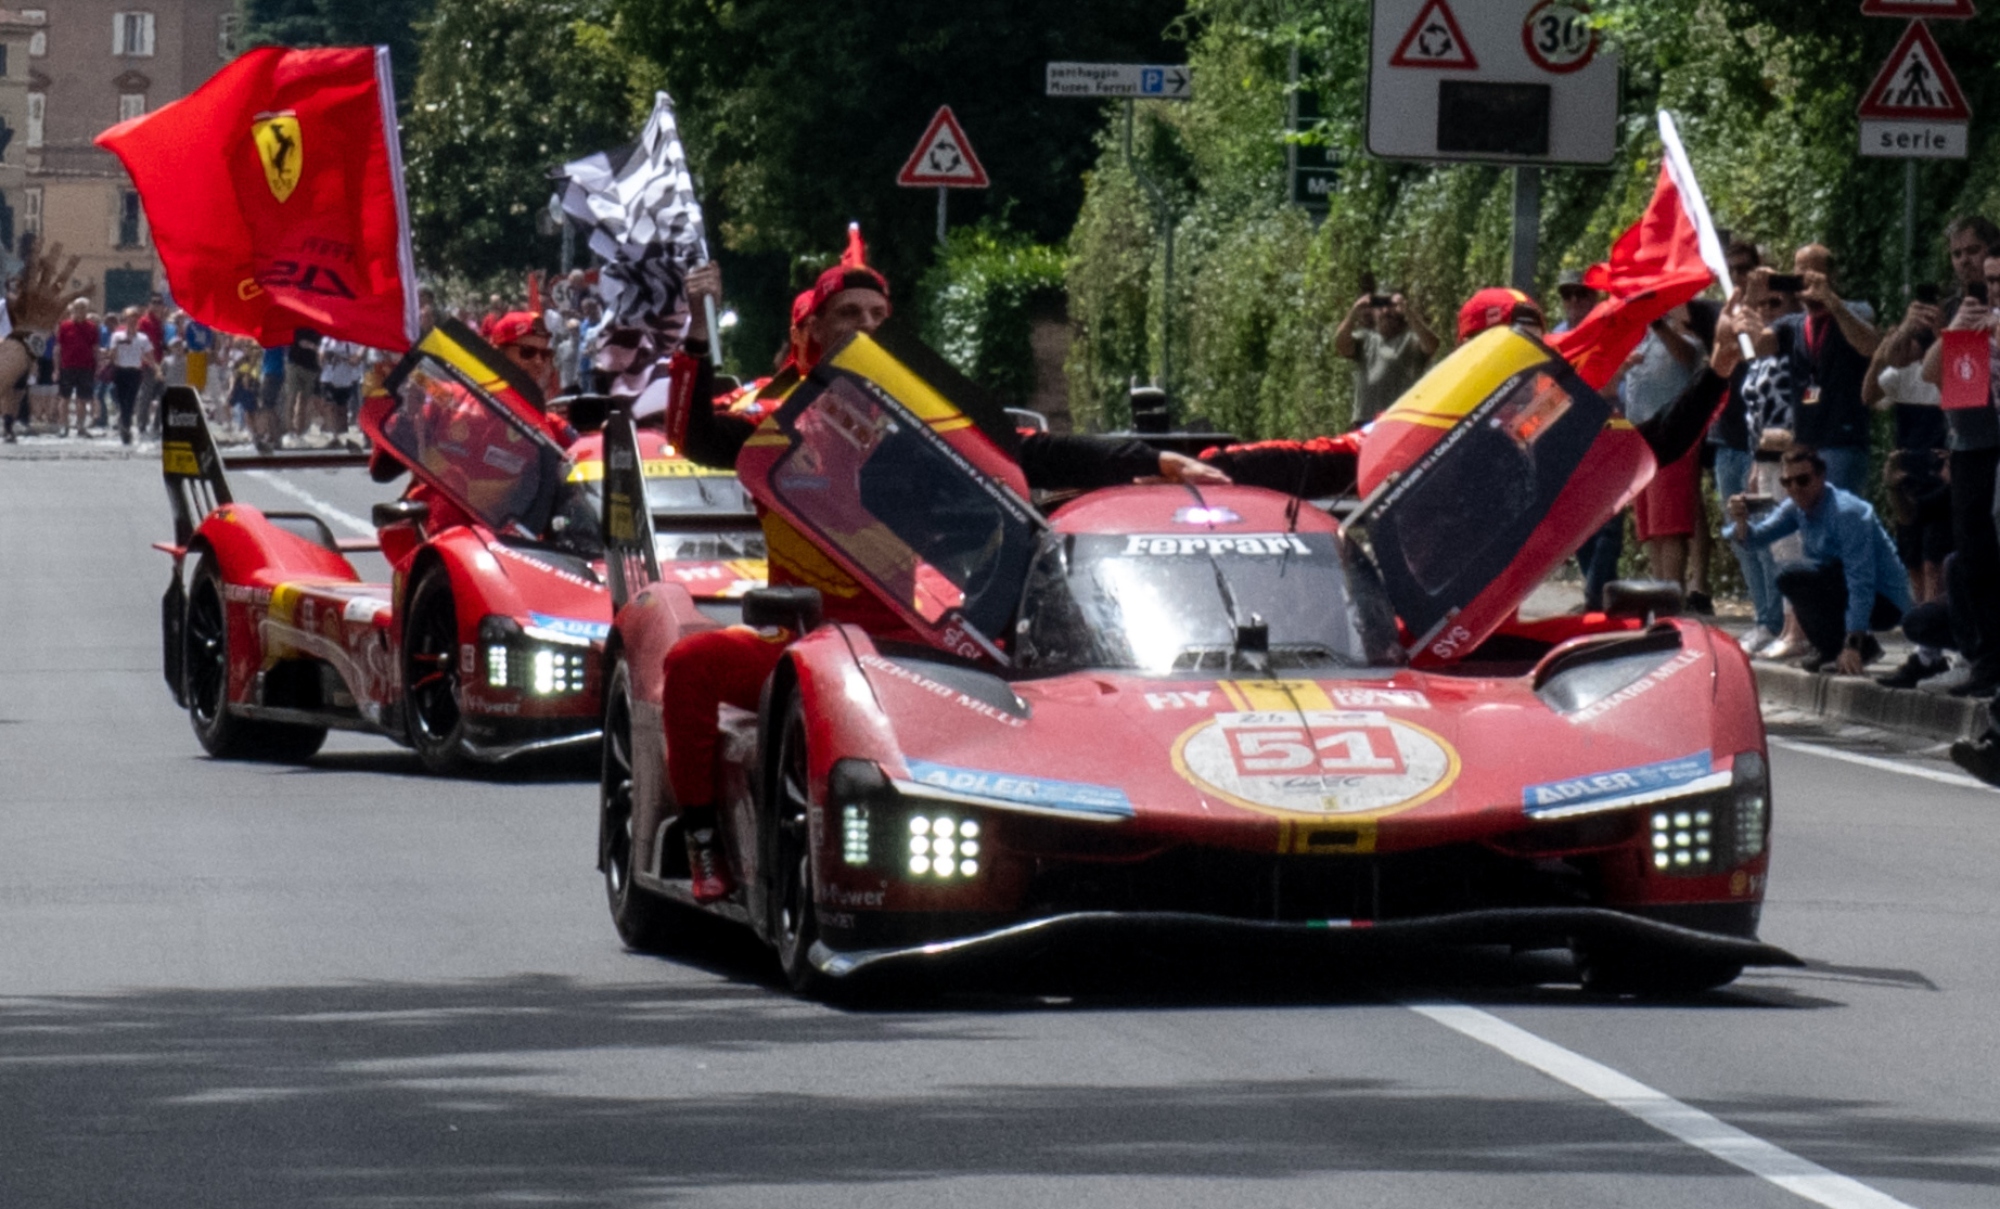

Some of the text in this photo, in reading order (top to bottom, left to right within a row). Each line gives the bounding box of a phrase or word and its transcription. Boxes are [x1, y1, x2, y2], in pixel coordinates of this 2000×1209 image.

[1539, 15, 1584, 54] 30
[1051, 82, 1137, 94] Museo Ferrari
[1880, 129, 1946, 149] serie
[1121, 533, 1312, 555] Ferrari
[1651, 649, 1706, 682] MILLE
[859, 655, 1027, 728] RICHARD MILLE
[1144, 690, 1212, 710] HY
[1235, 731, 1396, 769] 51
[926, 771, 1039, 796] ADLER
[1535, 772, 1639, 804] ADLER
